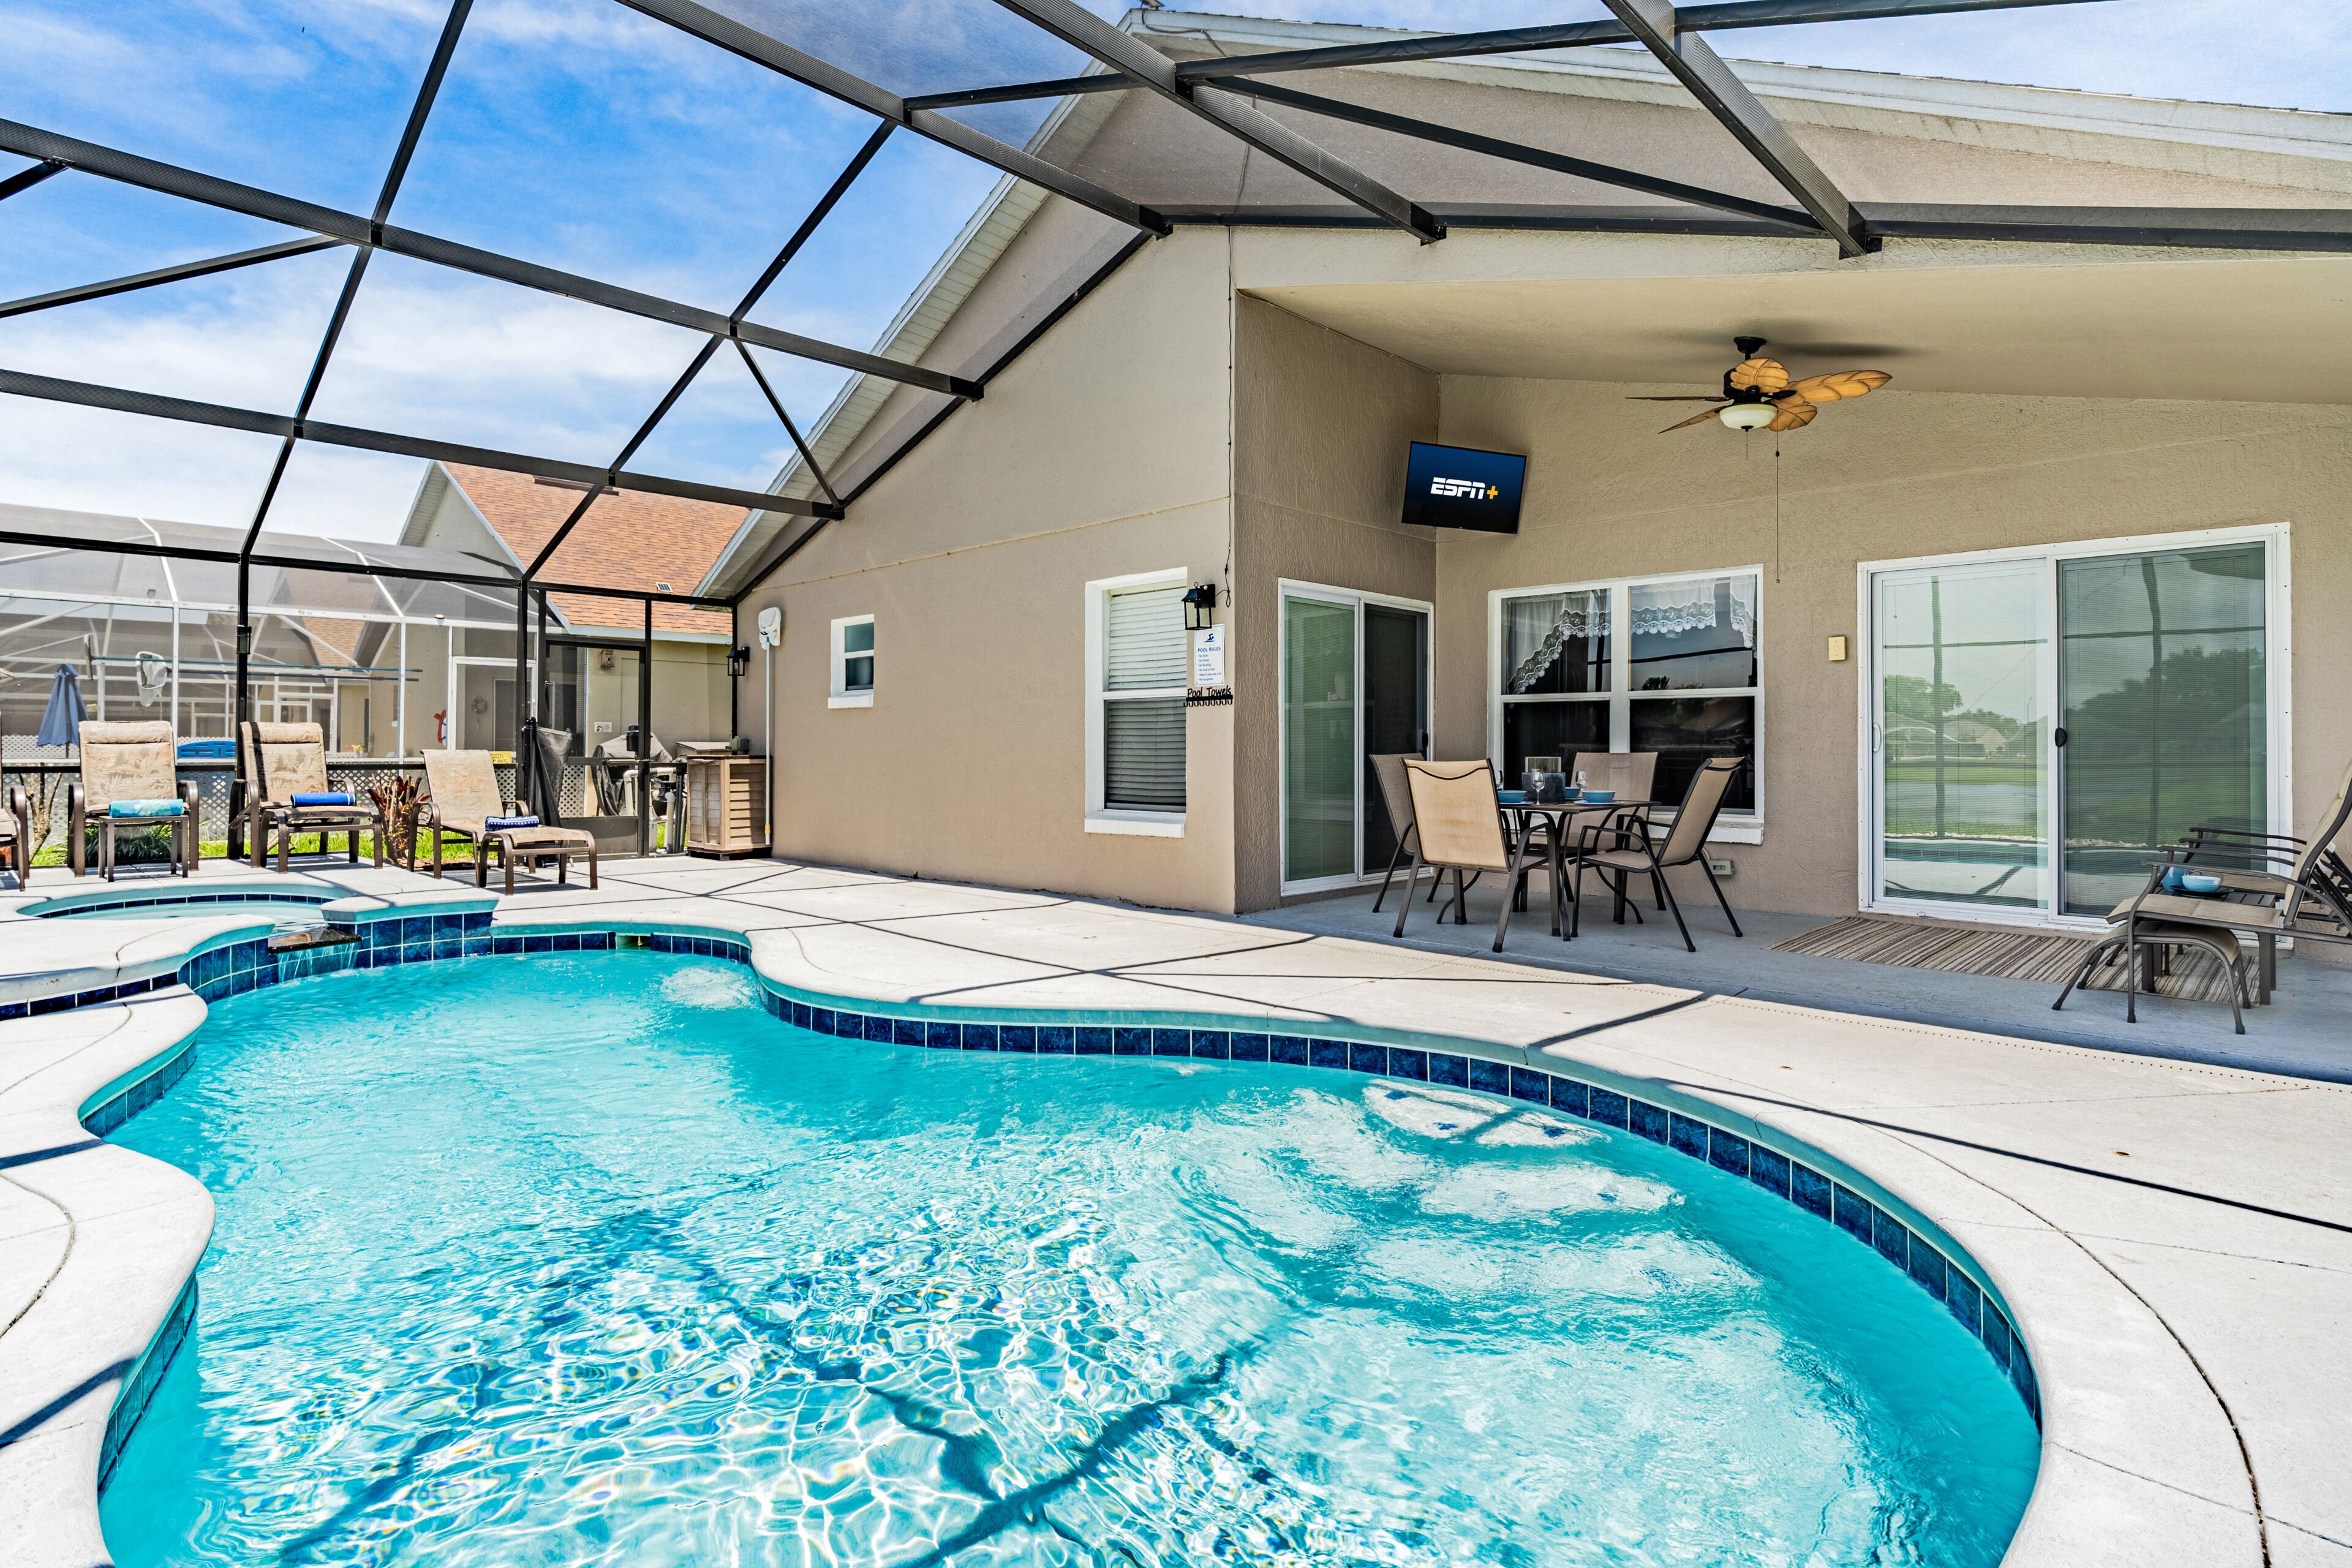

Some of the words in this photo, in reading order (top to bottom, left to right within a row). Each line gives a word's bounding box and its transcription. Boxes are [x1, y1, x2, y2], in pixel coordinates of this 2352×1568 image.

[1430, 477, 1498, 499] ESPN+
[1188, 687, 1202, 698] Pool
[1206, 685, 1231, 696] Towels
